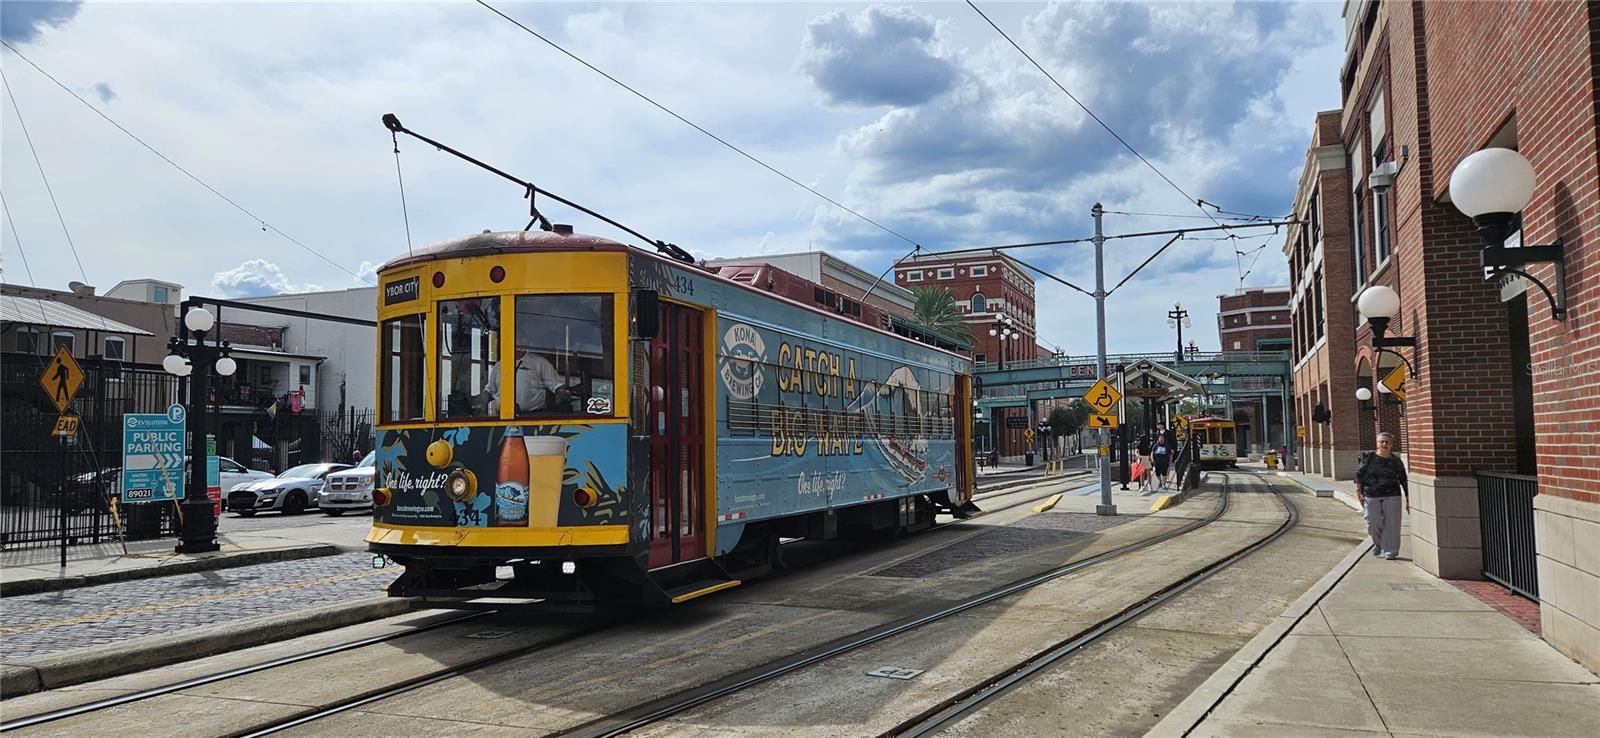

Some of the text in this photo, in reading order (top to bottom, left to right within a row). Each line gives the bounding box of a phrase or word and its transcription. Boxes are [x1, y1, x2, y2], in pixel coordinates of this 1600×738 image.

[386, 280, 419, 297] YBOR CITY
[674, 274, 695, 296] 434
[734, 327, 756, 346] KONA
[724, 369, 754, 395] BREWING
[777, 342, 856, 400] CATCH A
[133, 432, 177, 442] PUBLIC
[770, 408, 865, 457] BIG WAVE
[128, 442, 182, 453] PARKING
[128, 490, 151, 498] 89021
[385, 471, 448, 496] One life, right?
[798, 471, 811, 495] One
